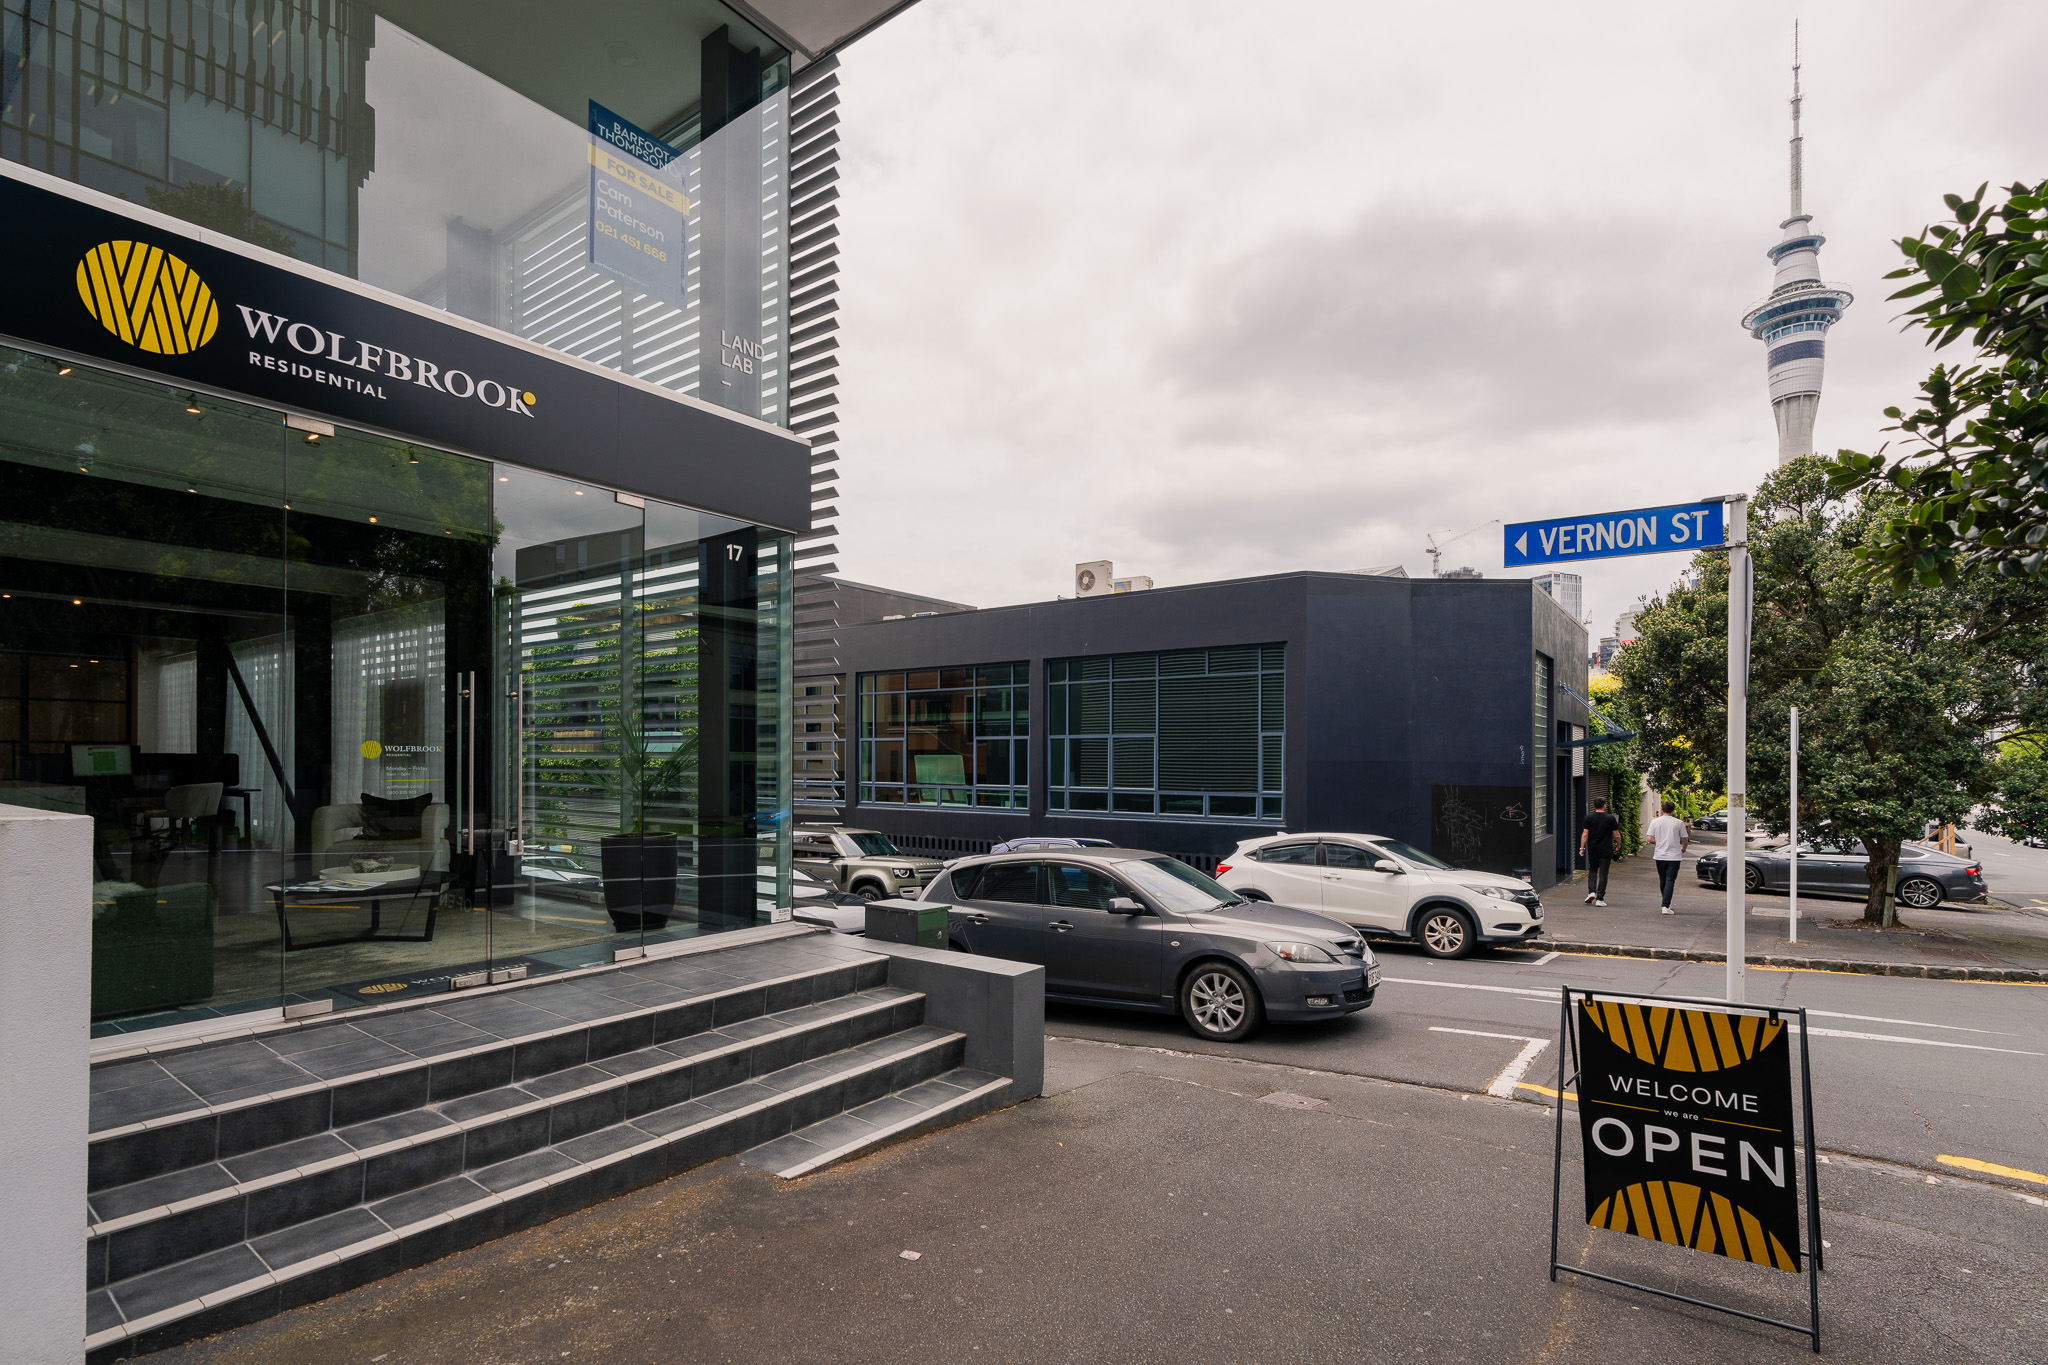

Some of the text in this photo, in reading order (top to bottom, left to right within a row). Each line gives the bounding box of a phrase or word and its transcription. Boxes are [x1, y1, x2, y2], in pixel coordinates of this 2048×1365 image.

[598, 124, 669, 171] THOMPSON
[614, 122, 669, 161] BARFOOT
[597, 179, 632, 208] Cam
[607, 158, 674, 203] FOR SALE
[597, 197, 664, 242] Paterson
[596, 220, 667, 262] 021 451 666
[236, 304, 536, 418] WOLFBROOK
[721, 329, 765, 360] LAND
[721, 349, 753, 375] LAB
[249, 351, 386, 399] RESIDENTIAL
[726, 544, 743, 561] 17
[1539, 510, 1709, 556] VERNON ST
[1609, 1074, 1758, 1113] WELCOME
[1664, 1109, 1699, 1121] we are
[1591, 1117, 1785, 1188] OPEN
